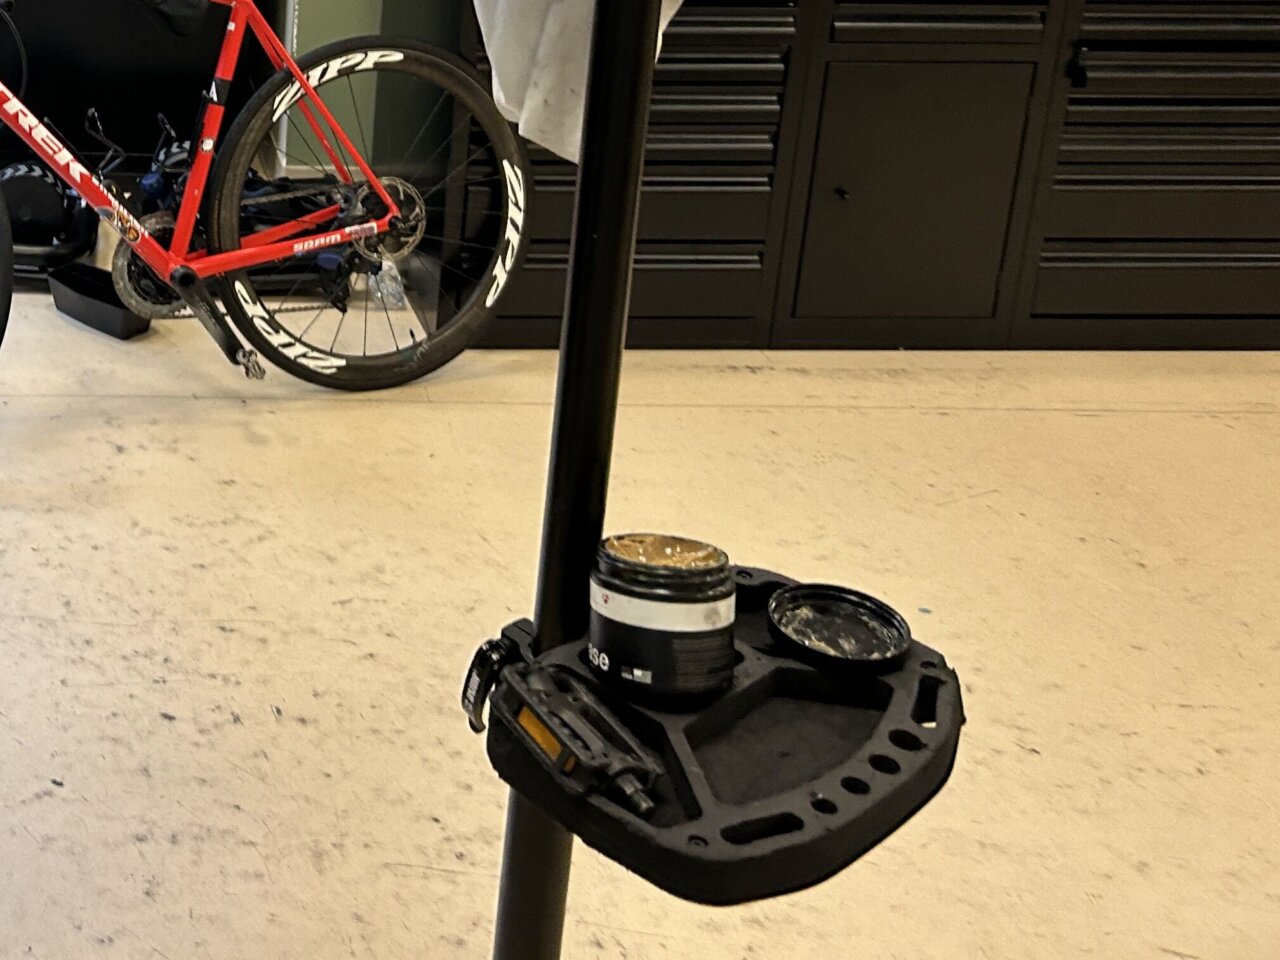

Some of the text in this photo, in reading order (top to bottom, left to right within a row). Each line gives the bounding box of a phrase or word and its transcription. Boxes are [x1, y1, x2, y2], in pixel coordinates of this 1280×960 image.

[271, 50, 405, 123] ZIPP
[485, 158, 525, 309] ZIPP
[234, 280, 347, 375] ZIPP
